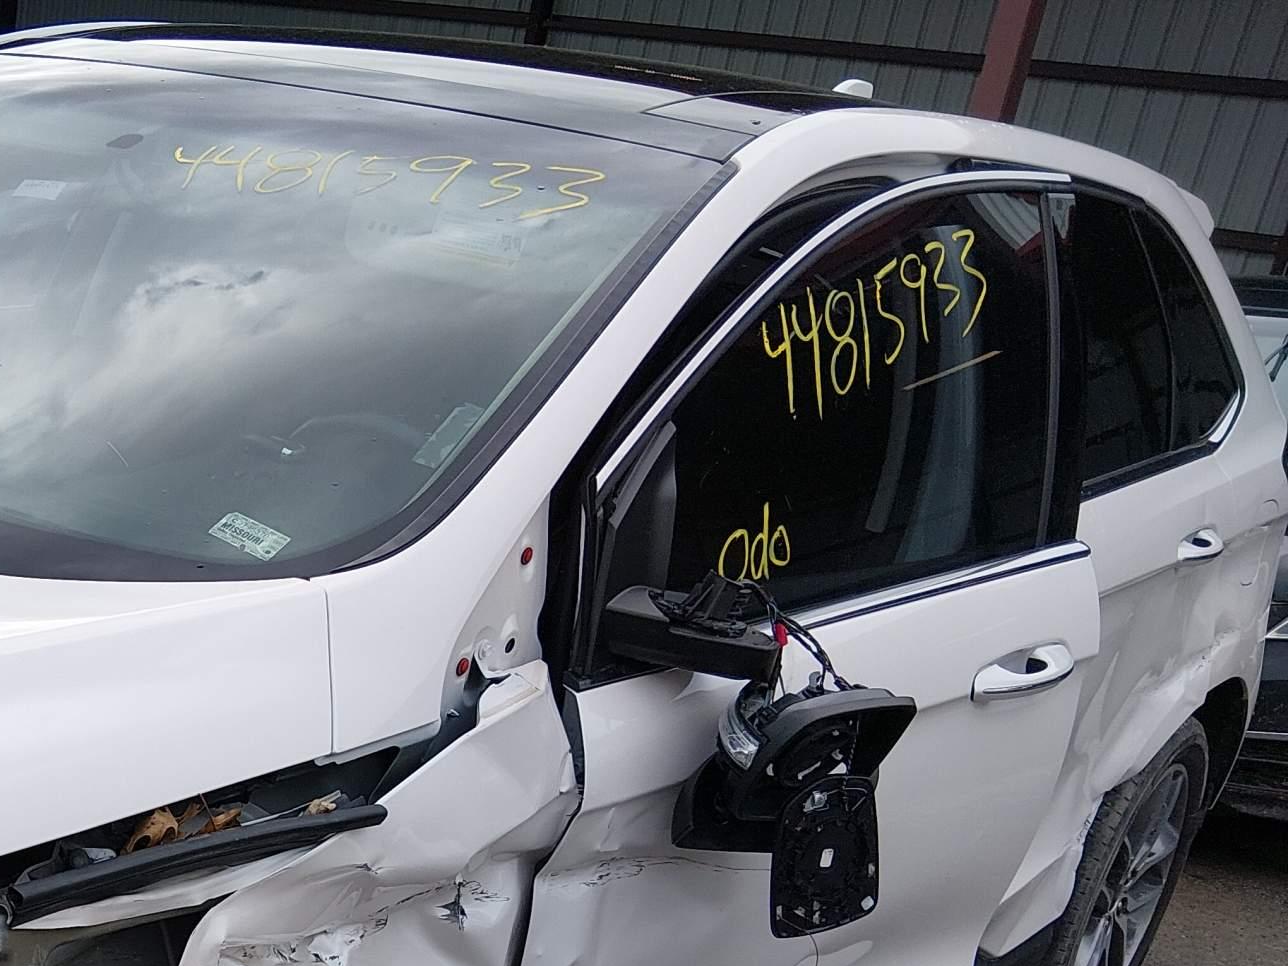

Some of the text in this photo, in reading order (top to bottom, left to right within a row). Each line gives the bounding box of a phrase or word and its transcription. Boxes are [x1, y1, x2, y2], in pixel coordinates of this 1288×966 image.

[174, 145, 607, 221] 44815933
[761, 228, 988, 421] 44815933
[220, 521, 265, 546] MISSOURI
